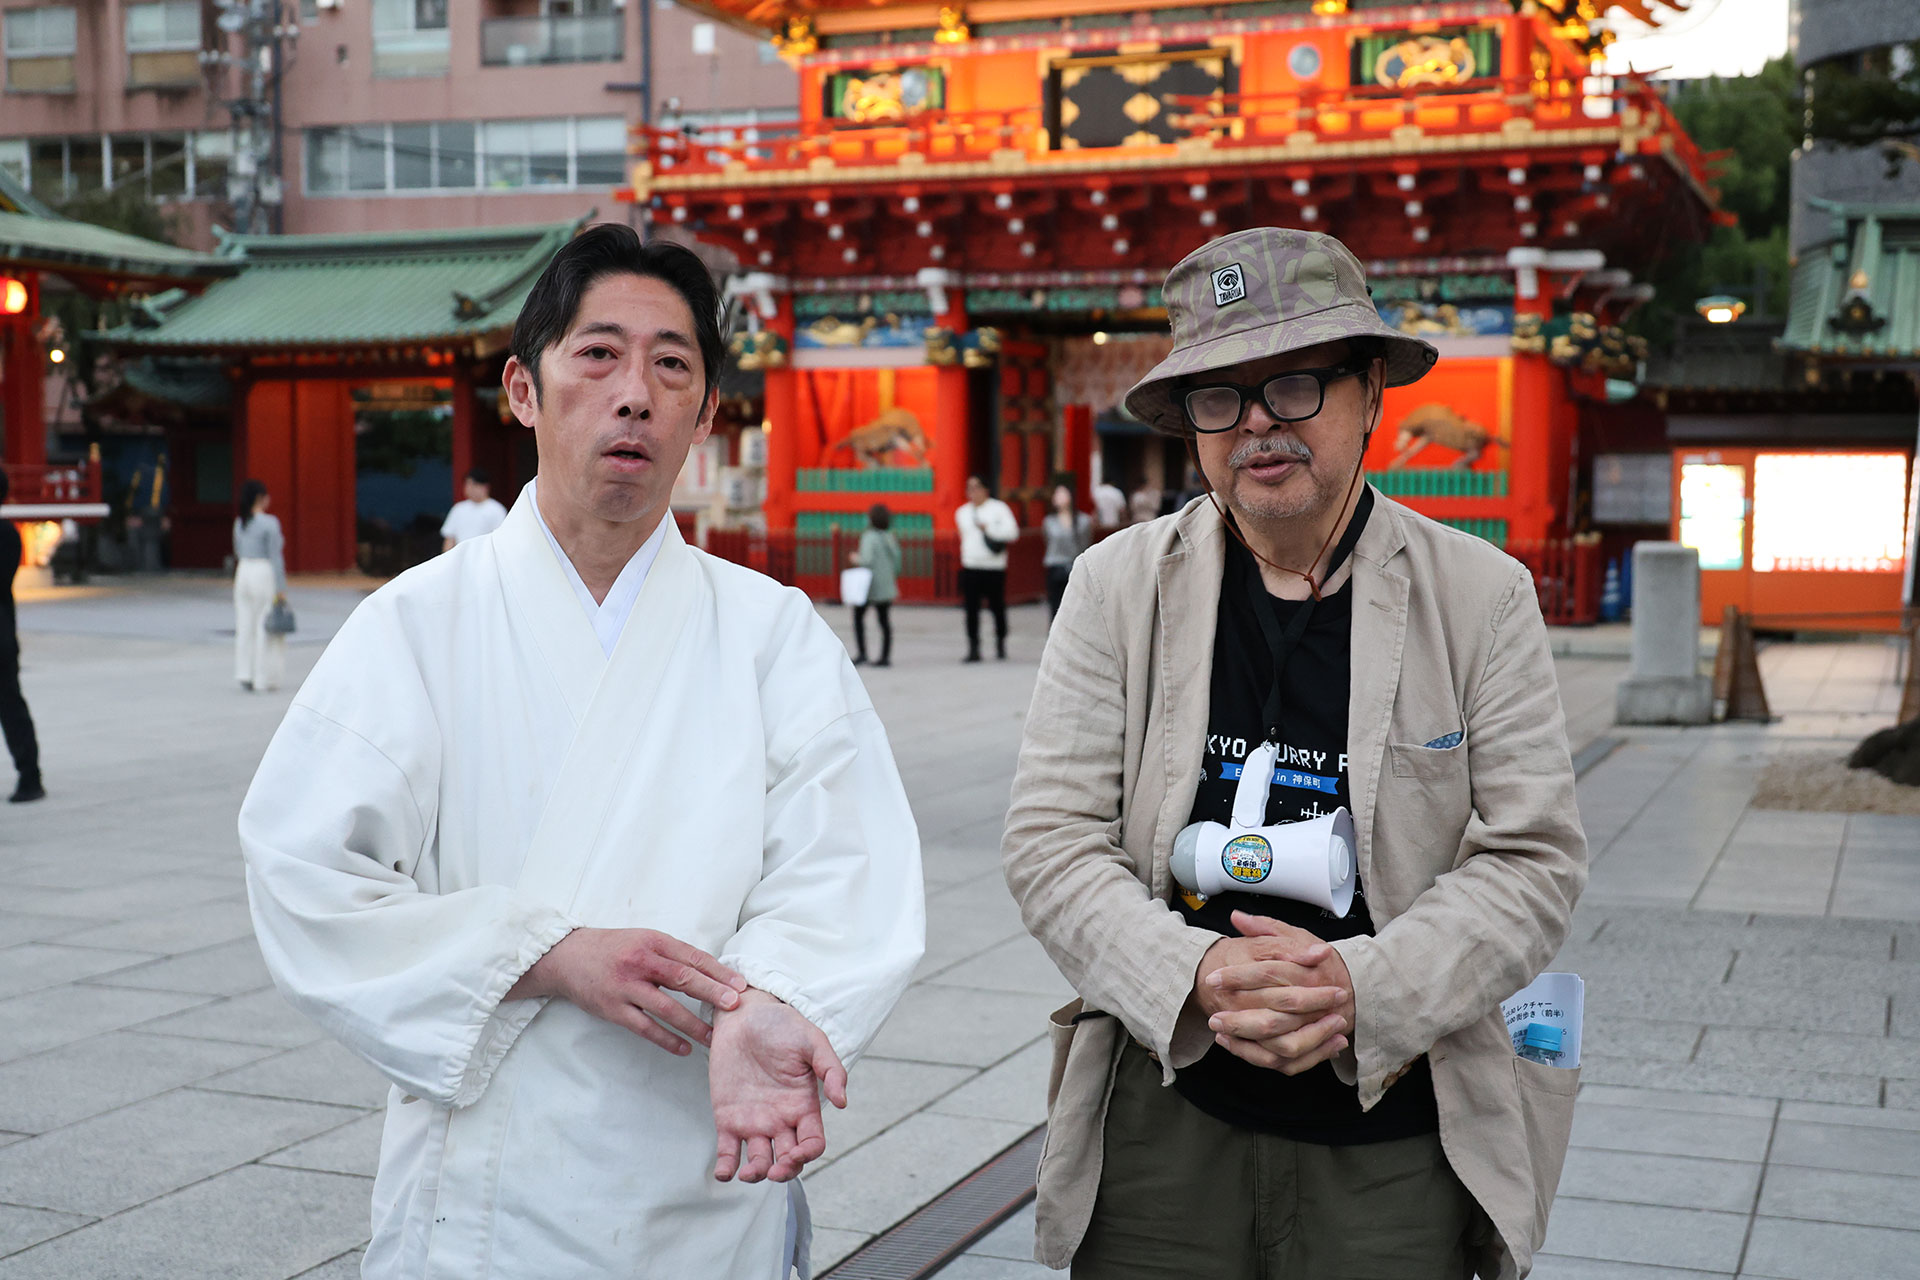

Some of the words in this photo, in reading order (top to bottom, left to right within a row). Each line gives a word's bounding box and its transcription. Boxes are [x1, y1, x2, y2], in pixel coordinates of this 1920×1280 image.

[1219, 287, 1242, 303] TAVARUA
[1207, 734, 1247, 758] KYO
[1262, 740, 1327, 771] URRY
[1276, 772, 1287, 783] in
[1292, 774, 1321, 789] 神保町
